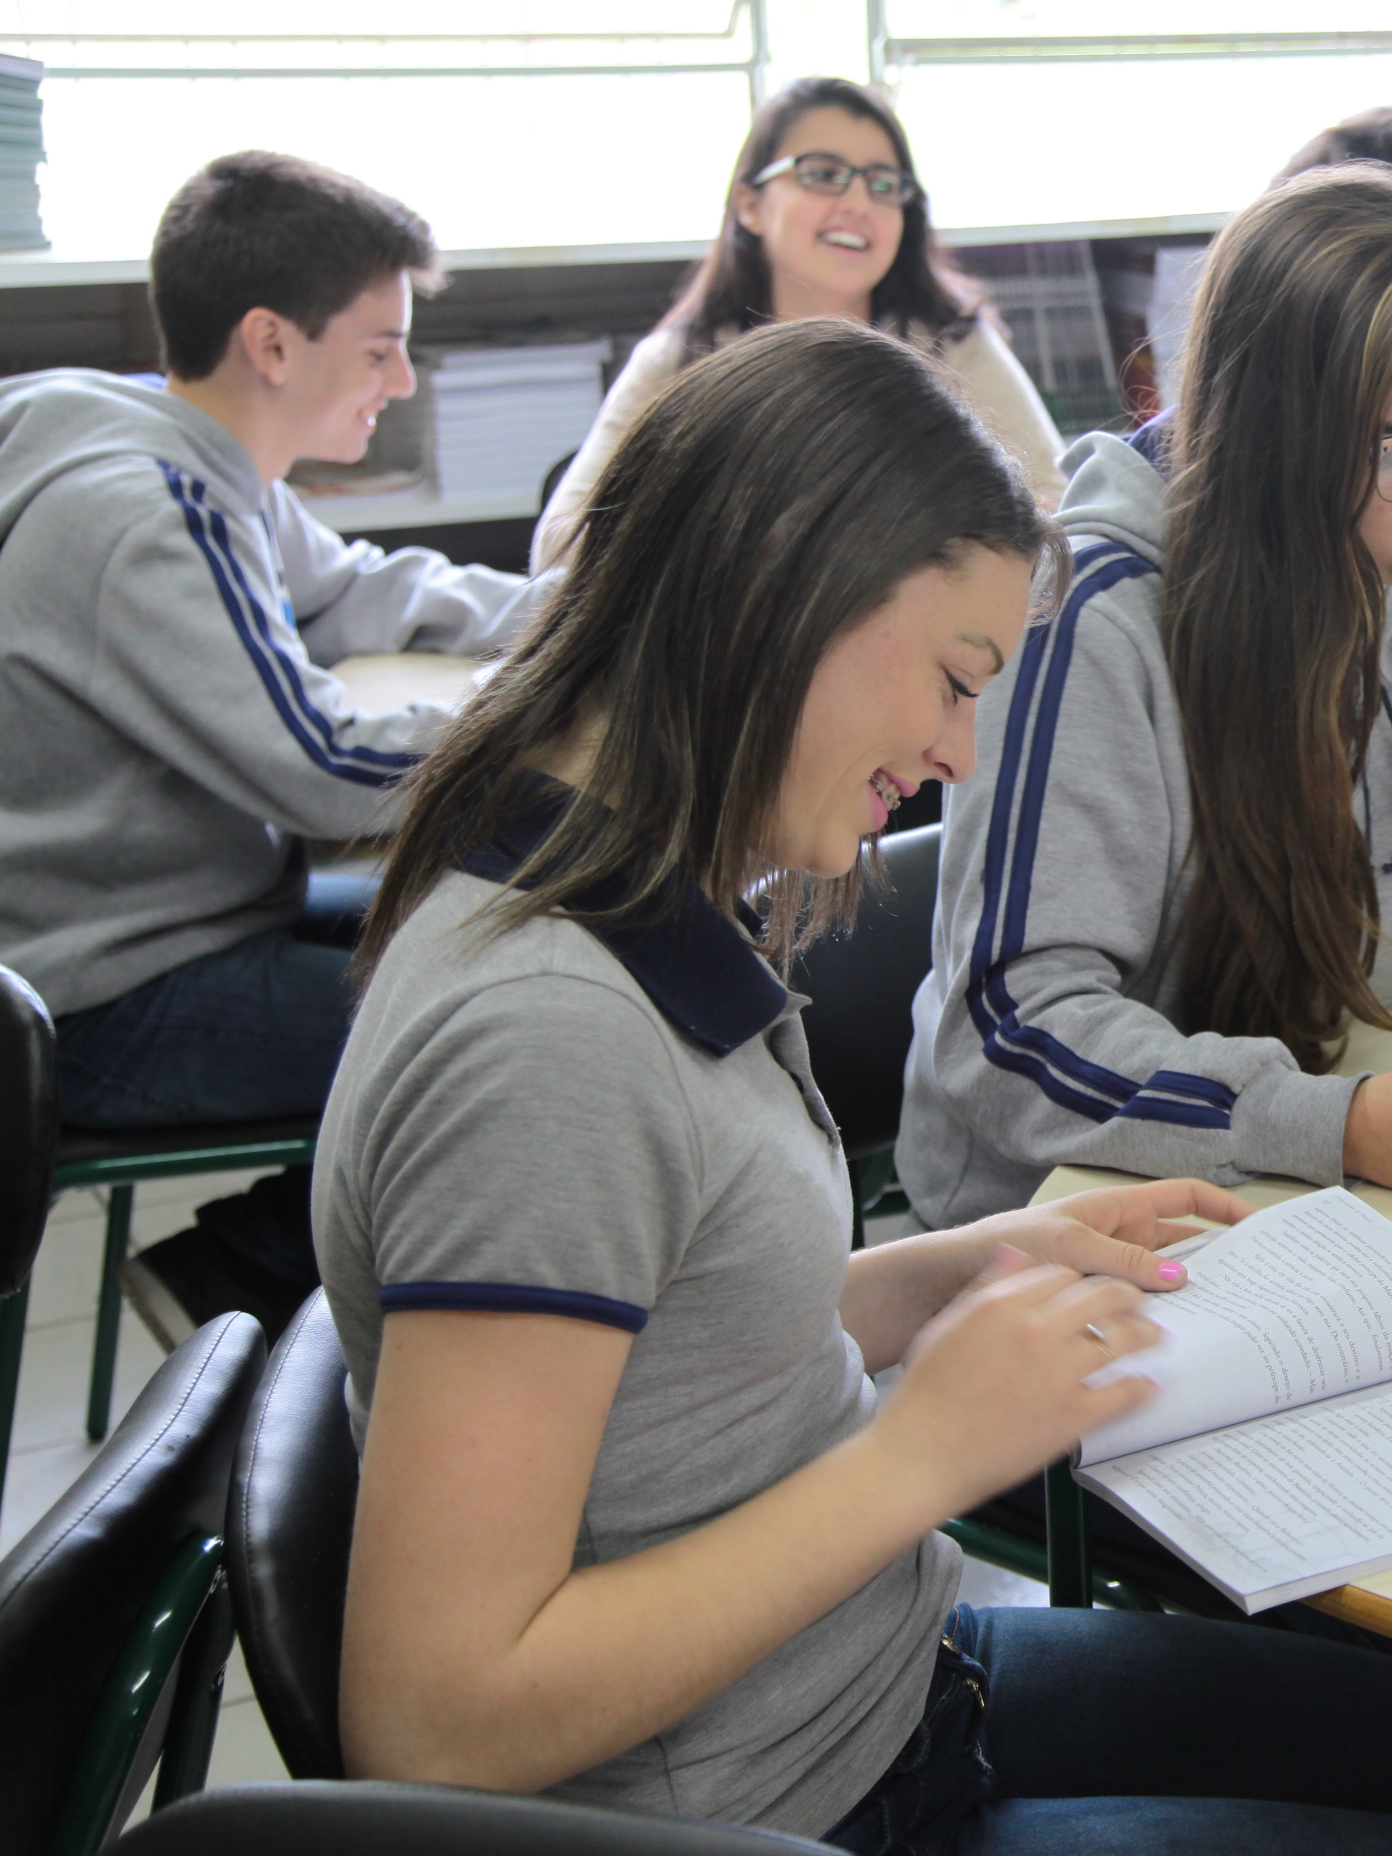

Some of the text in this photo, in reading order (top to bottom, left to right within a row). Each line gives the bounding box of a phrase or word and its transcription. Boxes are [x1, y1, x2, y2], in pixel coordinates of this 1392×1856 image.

[1319, 1295, 1342, 1321] encontrará
[1348, 1341, 1359, 1366] destino
[1336, 1282, 1356, 1304] confiante.
[1356, 1306, 1366, 1316] Até
[1362, 1318, 1372, 1332] que,
[1371, 1334, 1382, 1373] finalmente,
[1355, 1288, 1374, 1310] próprios
[1372, 1311, 1384, 1329] lábios
[1261, 1331, 1280, 1358] Seguindo
[1281, 1367, 1291, 1389] desejo
[1276, 1314, 1296, 1337] sonhando
[1294, 1338, 1311, 1370] acordado.
[1295, 1318, 1308, 1334] honra
[1311, 1346, 1324, 1376] desfrutar
[1314, 1305, 1326, 1317] serei
[1322, 1318, 1331, 1329] sua.
[1336, 1342, 1349, 1376] contrário,
[1264, 1364, 1278, 1393] príncipe
